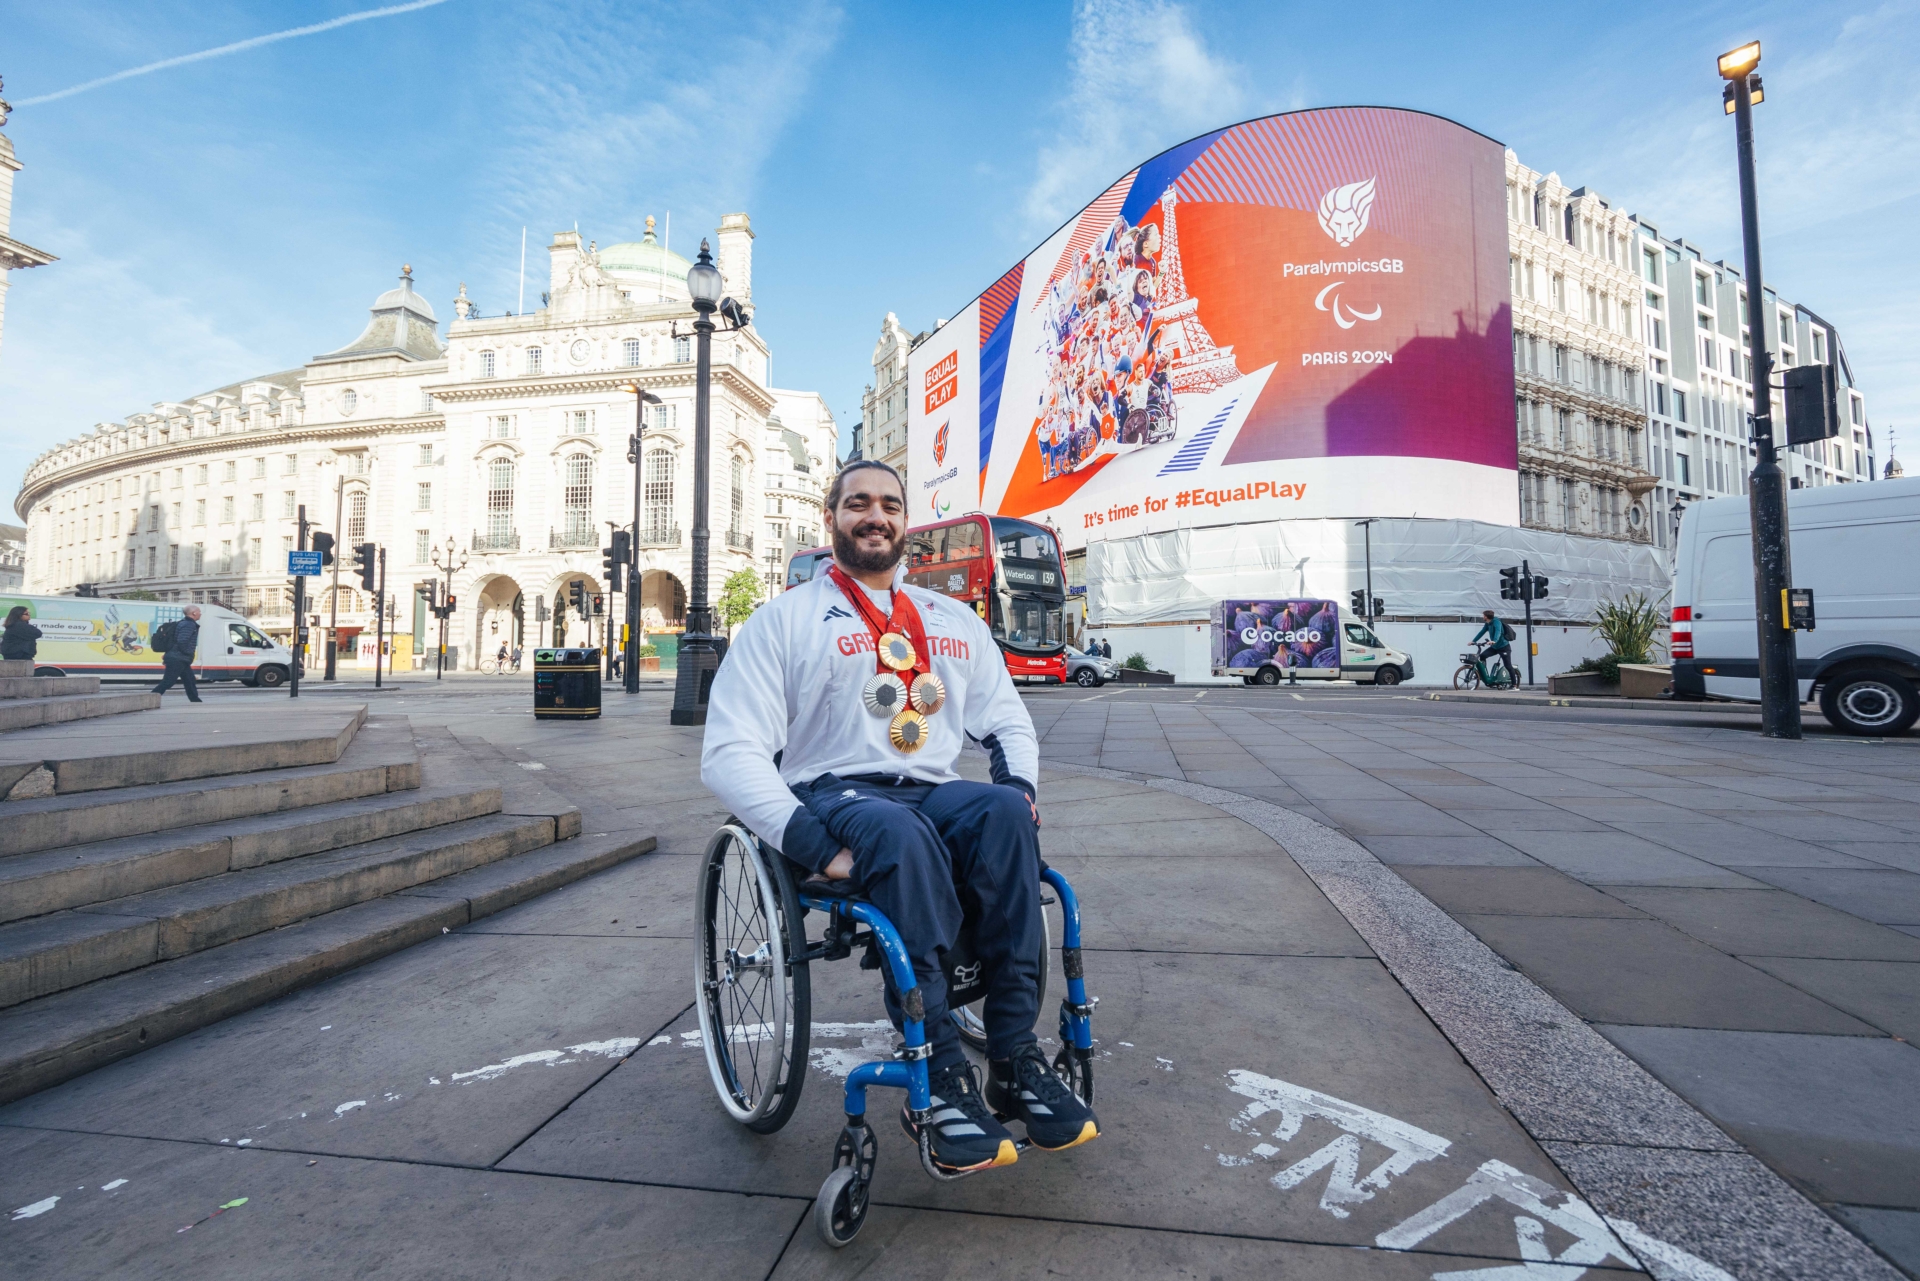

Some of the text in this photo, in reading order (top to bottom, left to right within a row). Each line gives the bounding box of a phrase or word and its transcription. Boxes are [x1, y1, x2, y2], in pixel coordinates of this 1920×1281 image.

[1283, 258, 1404, 278] ParalympicsGB
[1352, 350, 1393, 364] 2024
[925, 355, 957, 387] EQUAL
[928, 382, 953, 410] PLAY
[923, 467, 958, 490] ParalympicsGB
[1083, 481, 1307, 529] It's time for #EqualPlay
[1005, 569, 1055, 584] Waterloo 139
[837, 632, 970, 660] GRE TAIN
[1261, 627, 1321, 642] ocado
